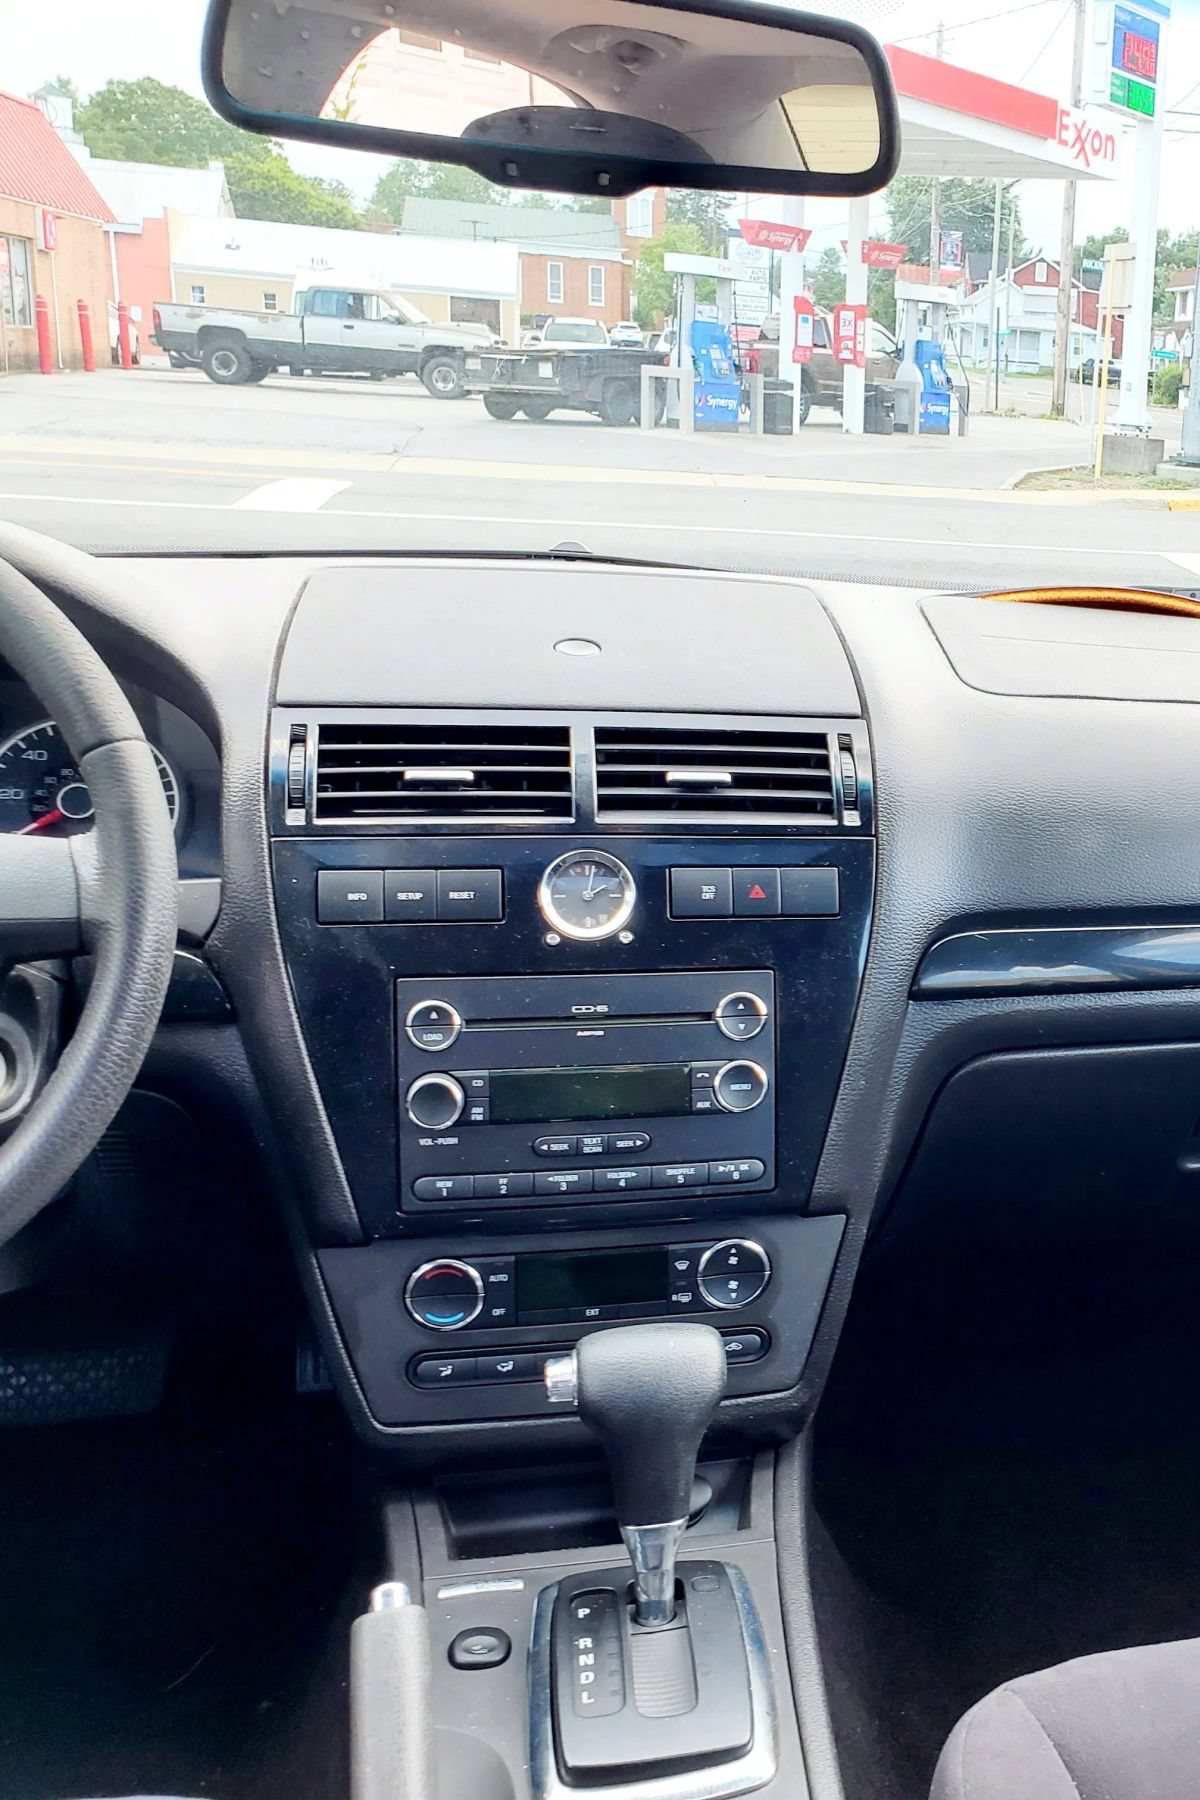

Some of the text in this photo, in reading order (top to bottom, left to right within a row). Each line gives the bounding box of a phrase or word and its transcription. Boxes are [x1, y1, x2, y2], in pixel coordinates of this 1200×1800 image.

[1058, 109, 1115, 168] Exxon
[841, 318, 853, 328] 3X
[706, 394, 737, 410] Synergy
[927, 402, 949, 416] Synergy
[22, 750, 47, 760] 40
[0, 788, 24, 799] 20
[701, 885, 716, 893] TCS
[449, 891, 475, 899] RESET
[423, 1033, 443, 1041] LOAD
[582, 1137, 602, 1145] TEXT
[616, 1140, 635, 1148] SEEK
[677, 1175, 684, 1183] 5
[733, 1171, 739, 1179] 6
[560, 1182, 567, 1190] 3
[618, 1179, 626, 1187] 4
[442, 1188, 447, 1196] 1
[500, 1185, 507, 1193] 2
[489, 1274, 508, 1282] AUTO
[492, 1308, 506, 1316] OFF
[585, 1308, 600, 1316] EXT
[577, 1608, 590, 1618] P
[578, 1638, 592, 1649] R
[578, 1654, 595, 1666] N
[579, 1671, 595, 1684] D
[581, 1691, 595, 1704] L
